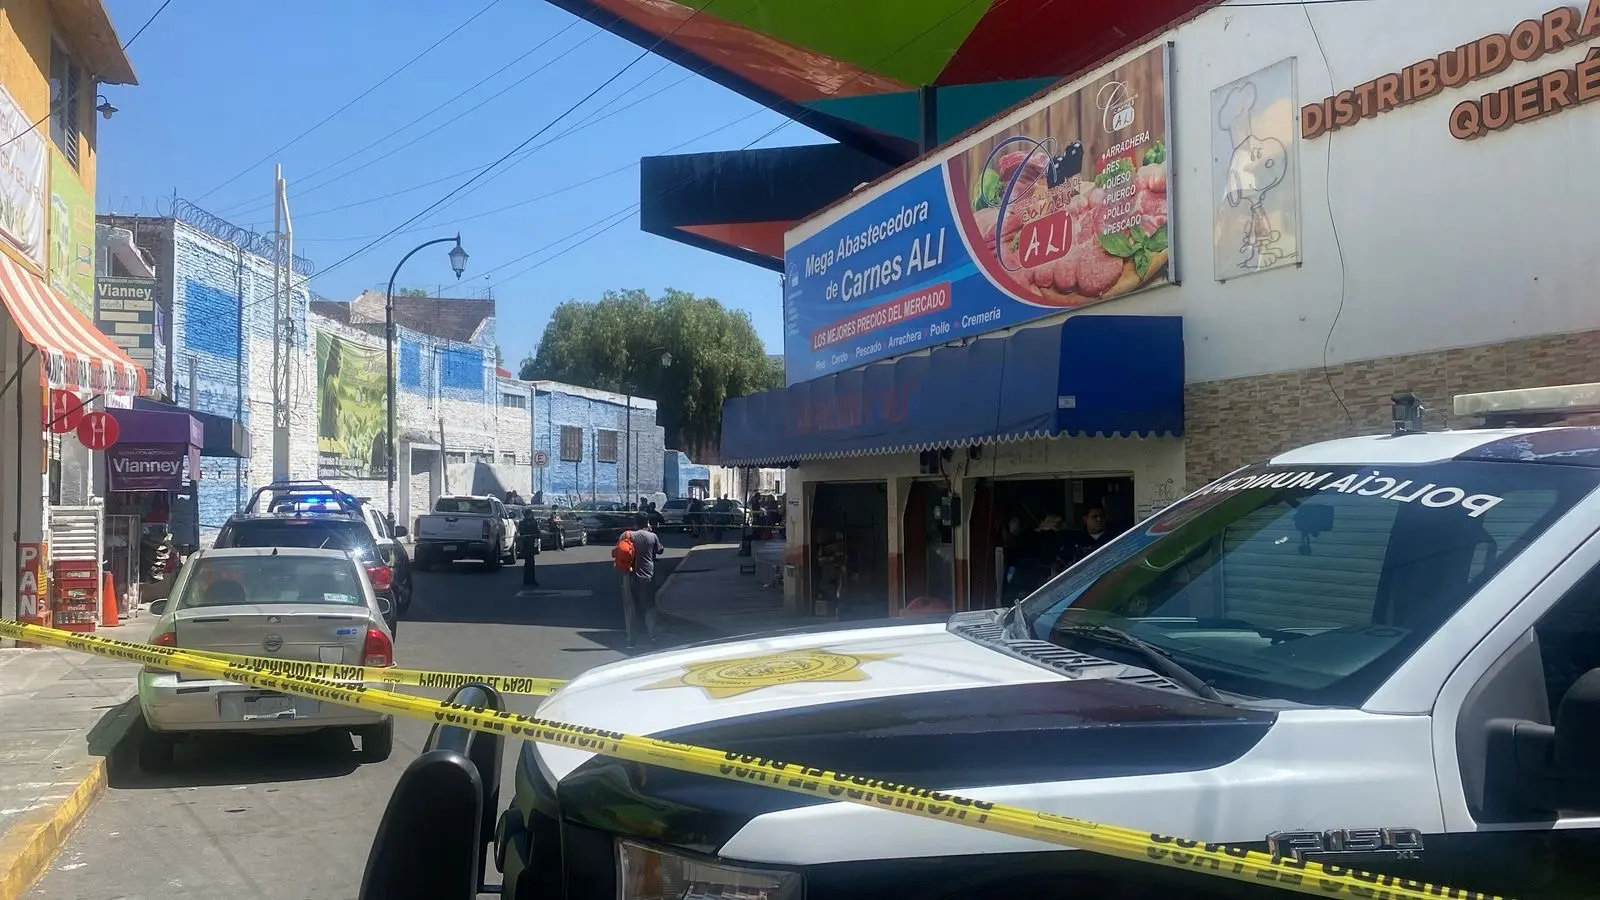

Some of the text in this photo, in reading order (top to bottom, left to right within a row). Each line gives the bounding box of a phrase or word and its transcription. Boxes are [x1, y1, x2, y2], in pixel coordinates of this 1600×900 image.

[1105, 130, 1150, 159] ARRACHERA
[1106, 160, 1120, 174] RES
[1106, 184, 1136, 205] PUERCO
[1106, 202, 1131, 219] POLLO
[1107, 214, 1142, 235] PESCADO
[805, 200, 929, 279] Mega Abastecedora
[826, 227, 946, 302] de Carnes ALI
[814, 289, 946, 349] LOS MEJORES PRECIOS DEL MERCADO
[856, 340, 882, 358] Pescado
[888, 329, 922, 349] Arrachera
[930, 321, 951, 337] Pollo
[961, 306, 1001, 329] Cremería
[113, 458, 180, 475] Vianney
[20, 546, 38, 617] PAN
